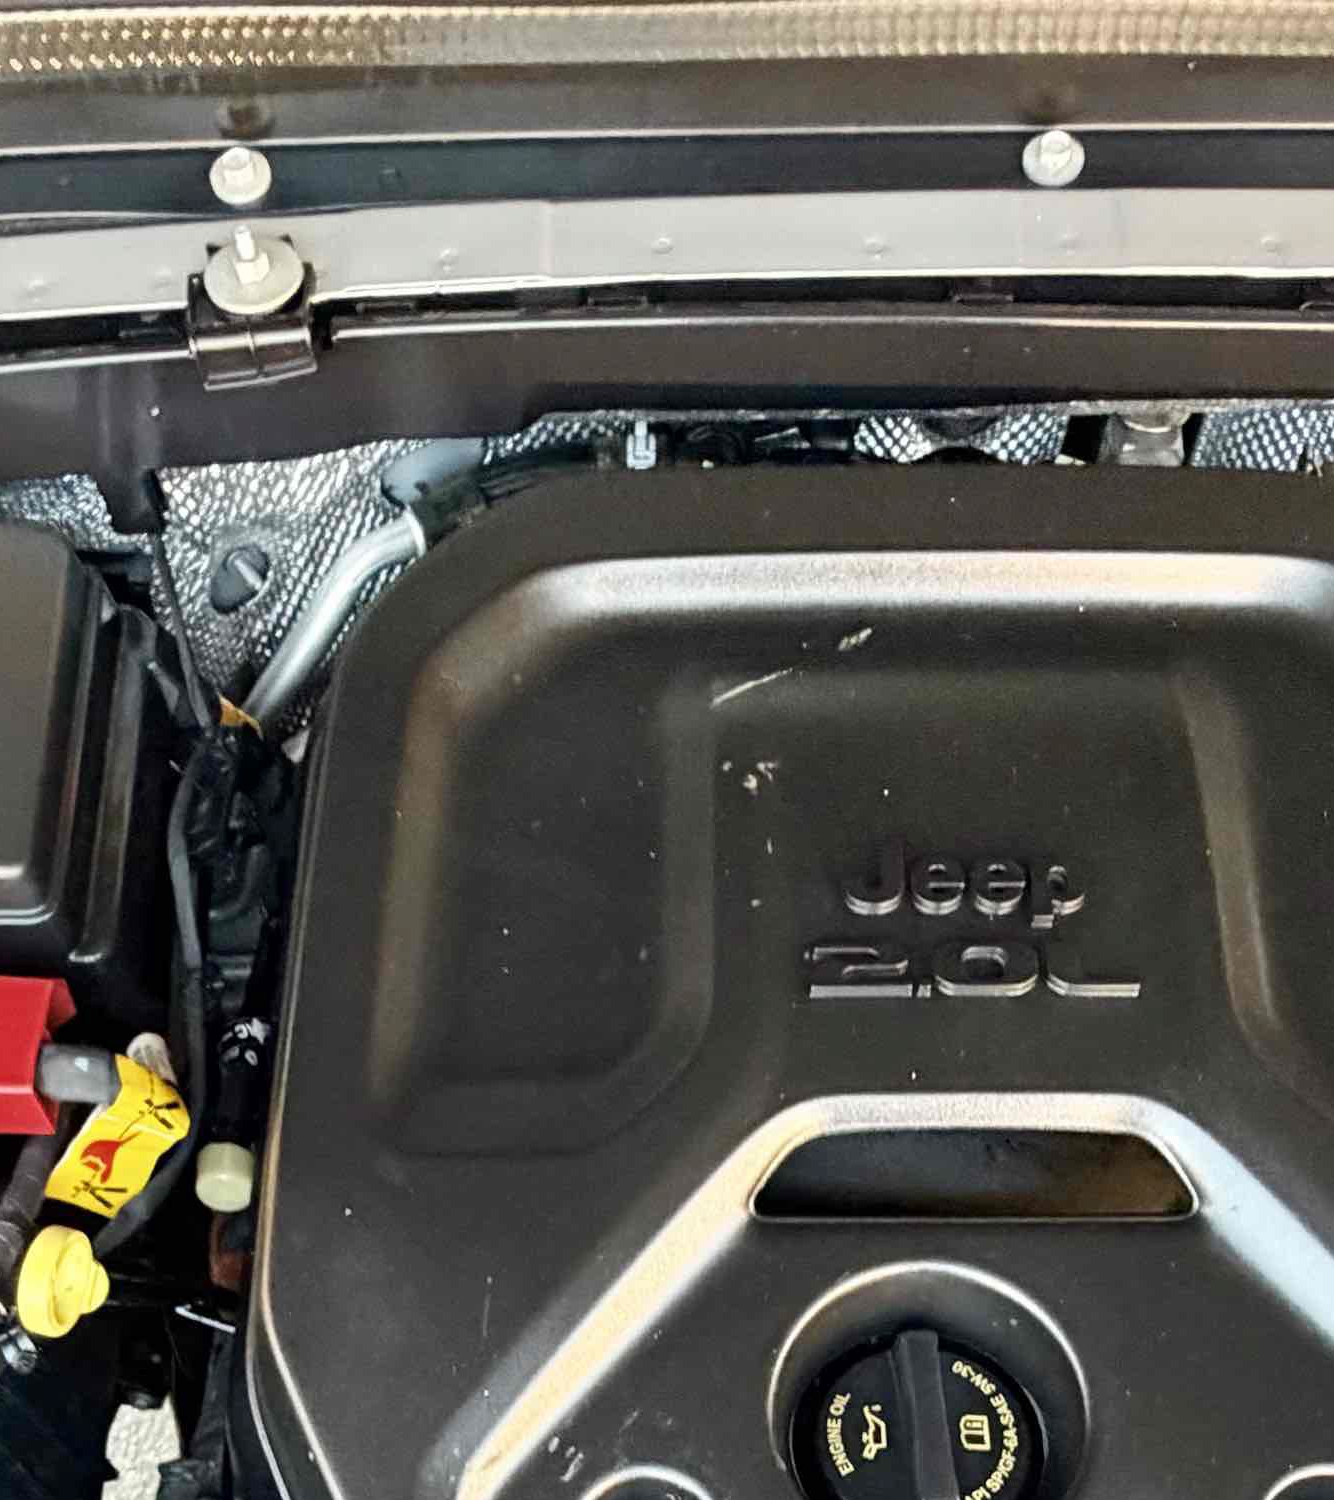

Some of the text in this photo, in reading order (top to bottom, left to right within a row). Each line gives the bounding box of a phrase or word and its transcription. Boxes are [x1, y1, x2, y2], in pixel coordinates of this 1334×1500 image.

[842, 838, 1086, 930] Jeep
[803, 940, 1142, 999] 2.0L
[951, 1360, 998, 1396] 5W-30
[826, 1391, 856, 1477] ENGINE OIL
